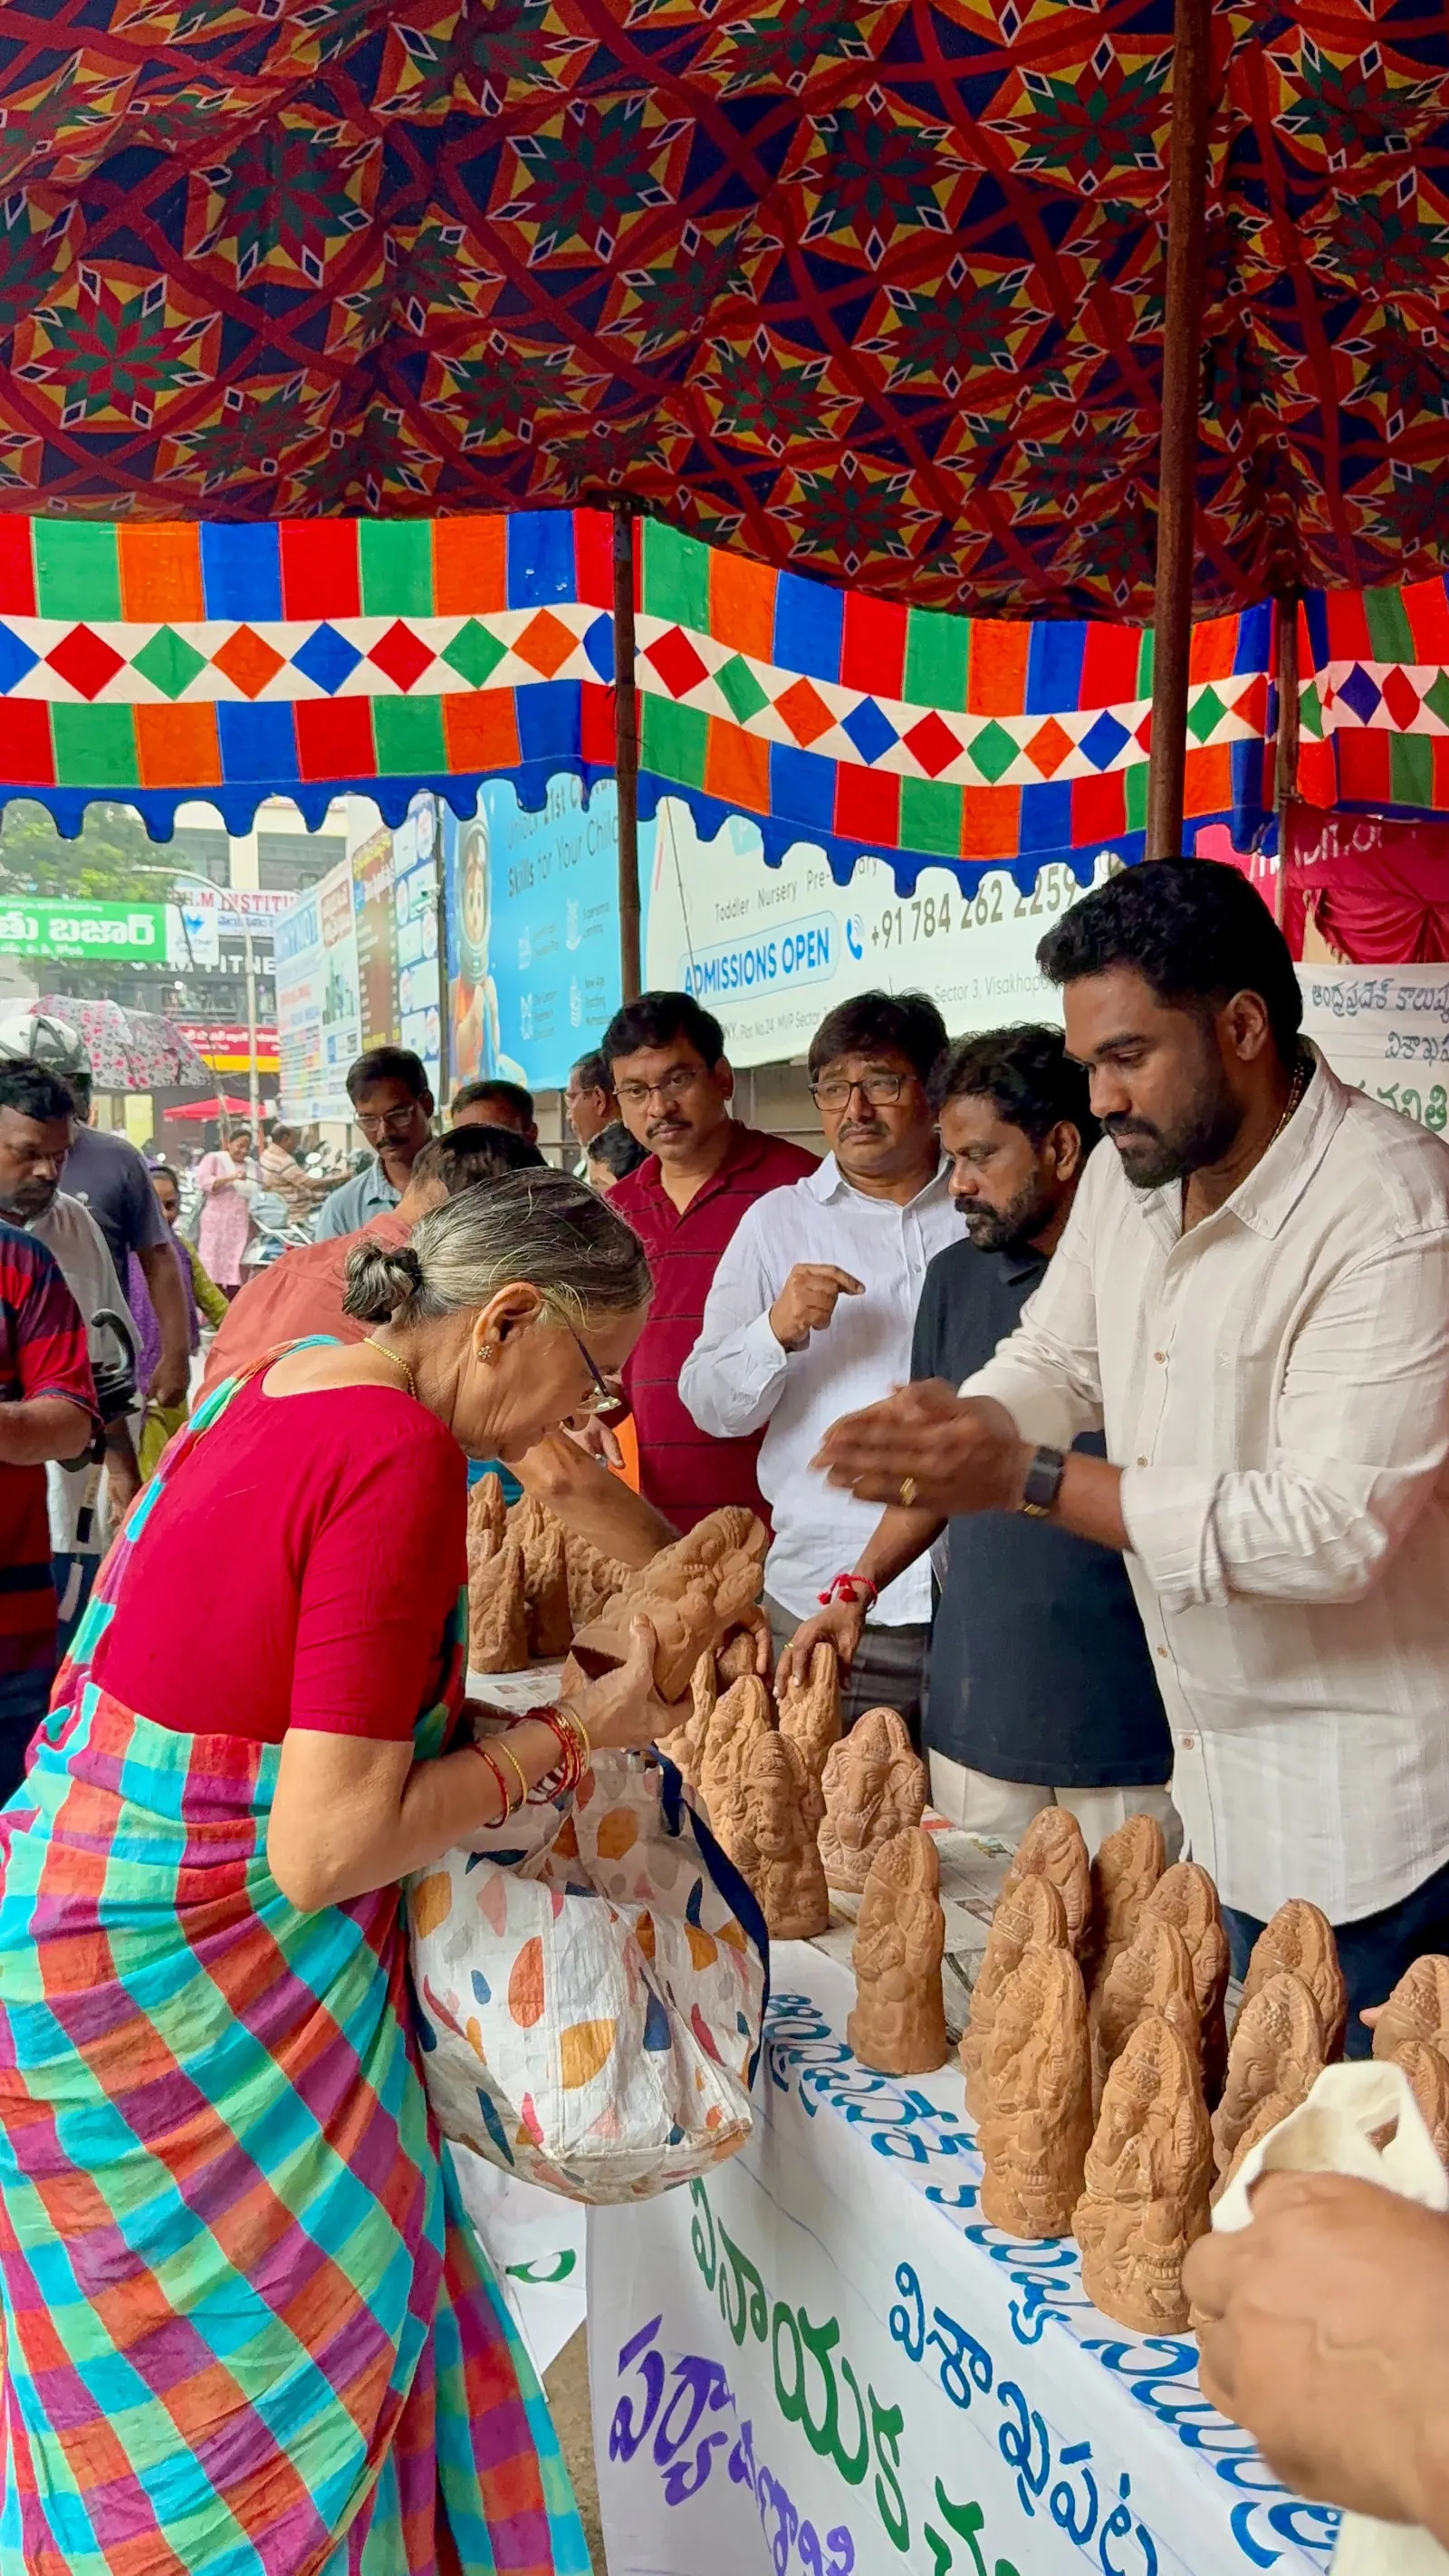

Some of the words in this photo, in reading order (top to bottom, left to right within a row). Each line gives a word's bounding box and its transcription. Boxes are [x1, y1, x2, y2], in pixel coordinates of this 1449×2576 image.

[509, 860, 534, 898] Skills
[537, 851, 552, 880] for
[556, 835, 582, 870] Your
[715, 895, 750, 923] Toddler
[757, 878, 797, 908] Nursery
[871, 907, 902, 948] +91
[911, 893, 951, 942] 784
[961, 879, 1003, 929] 262
[685, 943, 777, 995] ADMISSIONS
[782, 928, 830, 974] OPEN
[933, 985, 969, 1004] Sector
